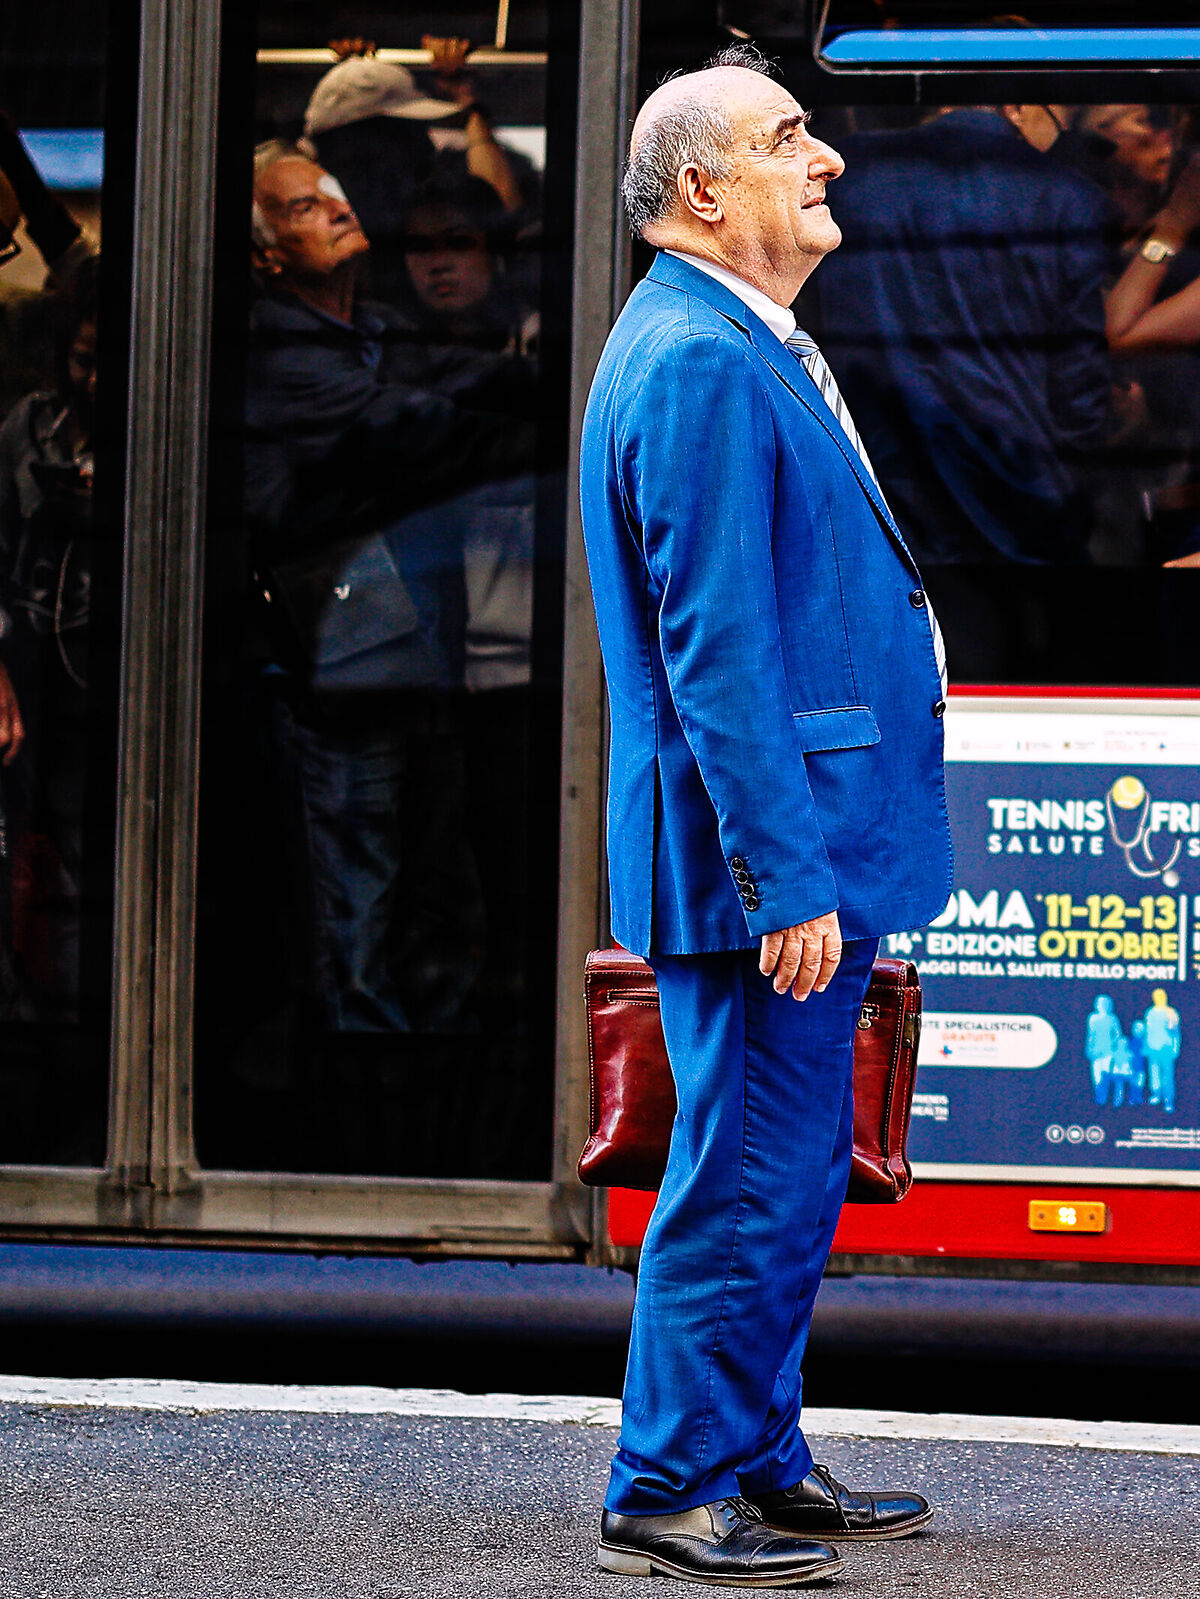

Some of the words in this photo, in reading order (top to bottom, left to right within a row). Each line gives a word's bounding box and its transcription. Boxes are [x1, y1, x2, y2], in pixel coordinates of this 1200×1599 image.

[987, 798, 1106, 831] TENNIS
[987, 834, 1104, 855] SALUTE
[1044, 894, 1178, 930] 11-12-13
[926, 932, 1037, 957] EDIZIONE
[1038, 929, 1179, 960] OTTOBRE
[958, 961, 1005, 977] DELLA
[1007, 963, 1063, 978] SALUTE
[1064, 965, 1075, 978] E
[1076, 964, 1124, 979] DELLO
[1126, 966, 1177, 980] SPORT
[944, 1020, 1033, 1032] SPECIALISTICHE
[941, 1032, 996, 1042] GRATUITE
